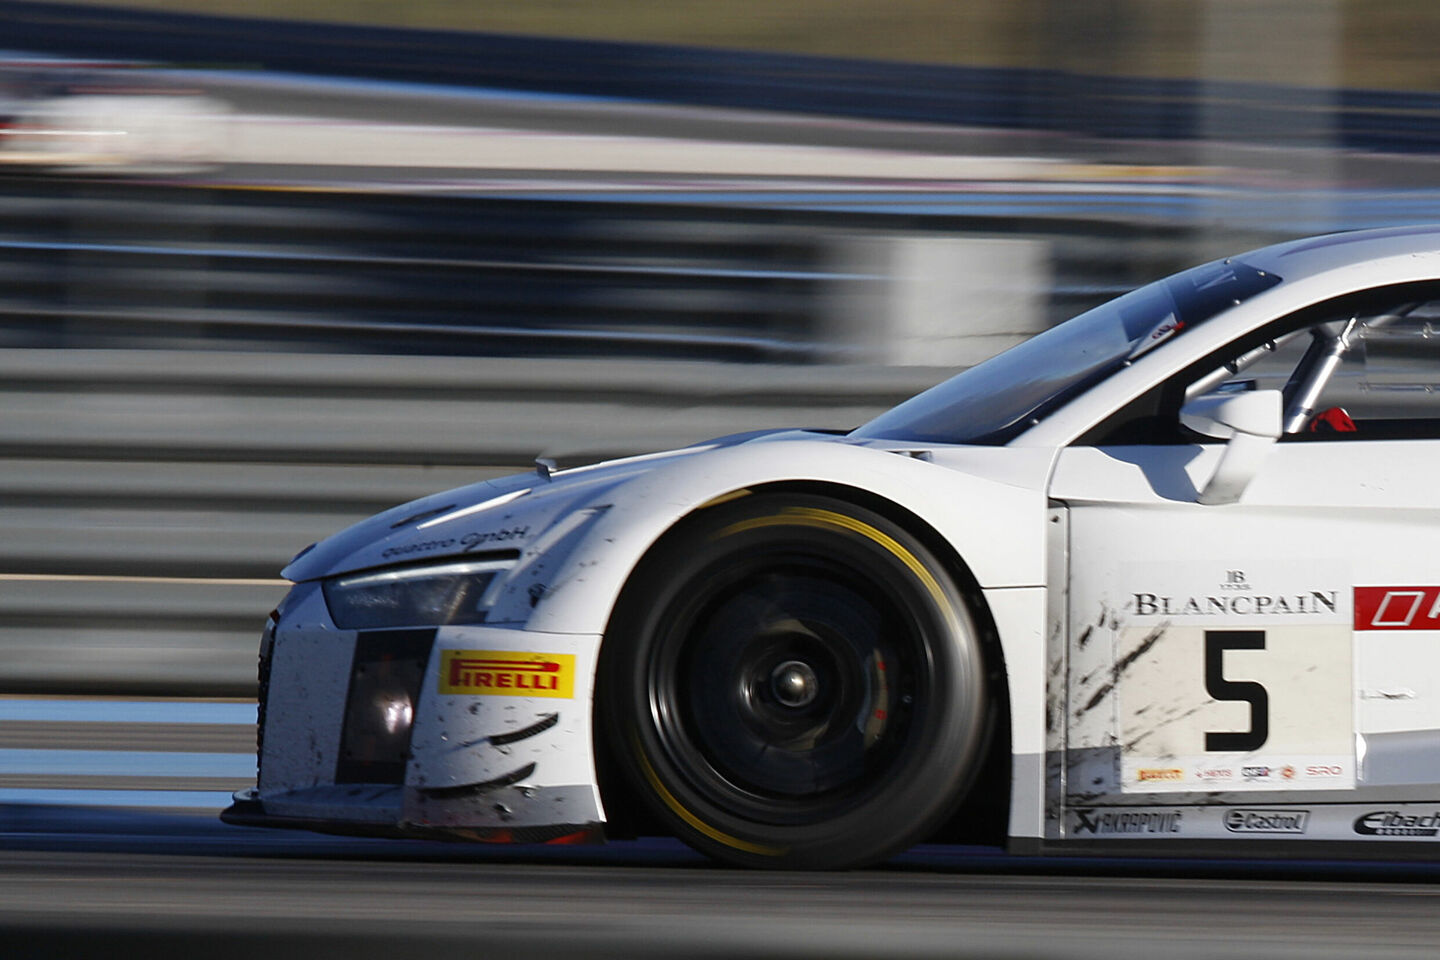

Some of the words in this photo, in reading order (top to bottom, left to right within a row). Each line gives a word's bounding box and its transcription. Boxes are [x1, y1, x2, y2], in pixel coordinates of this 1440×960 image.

[1133, 591, 1340, 616] BLANCPAIN
[449, 658, 561, 691] PIRELLI
[1204, 630, 1269, 752] 5
[1246, 811, 1301, 830] Castrol
